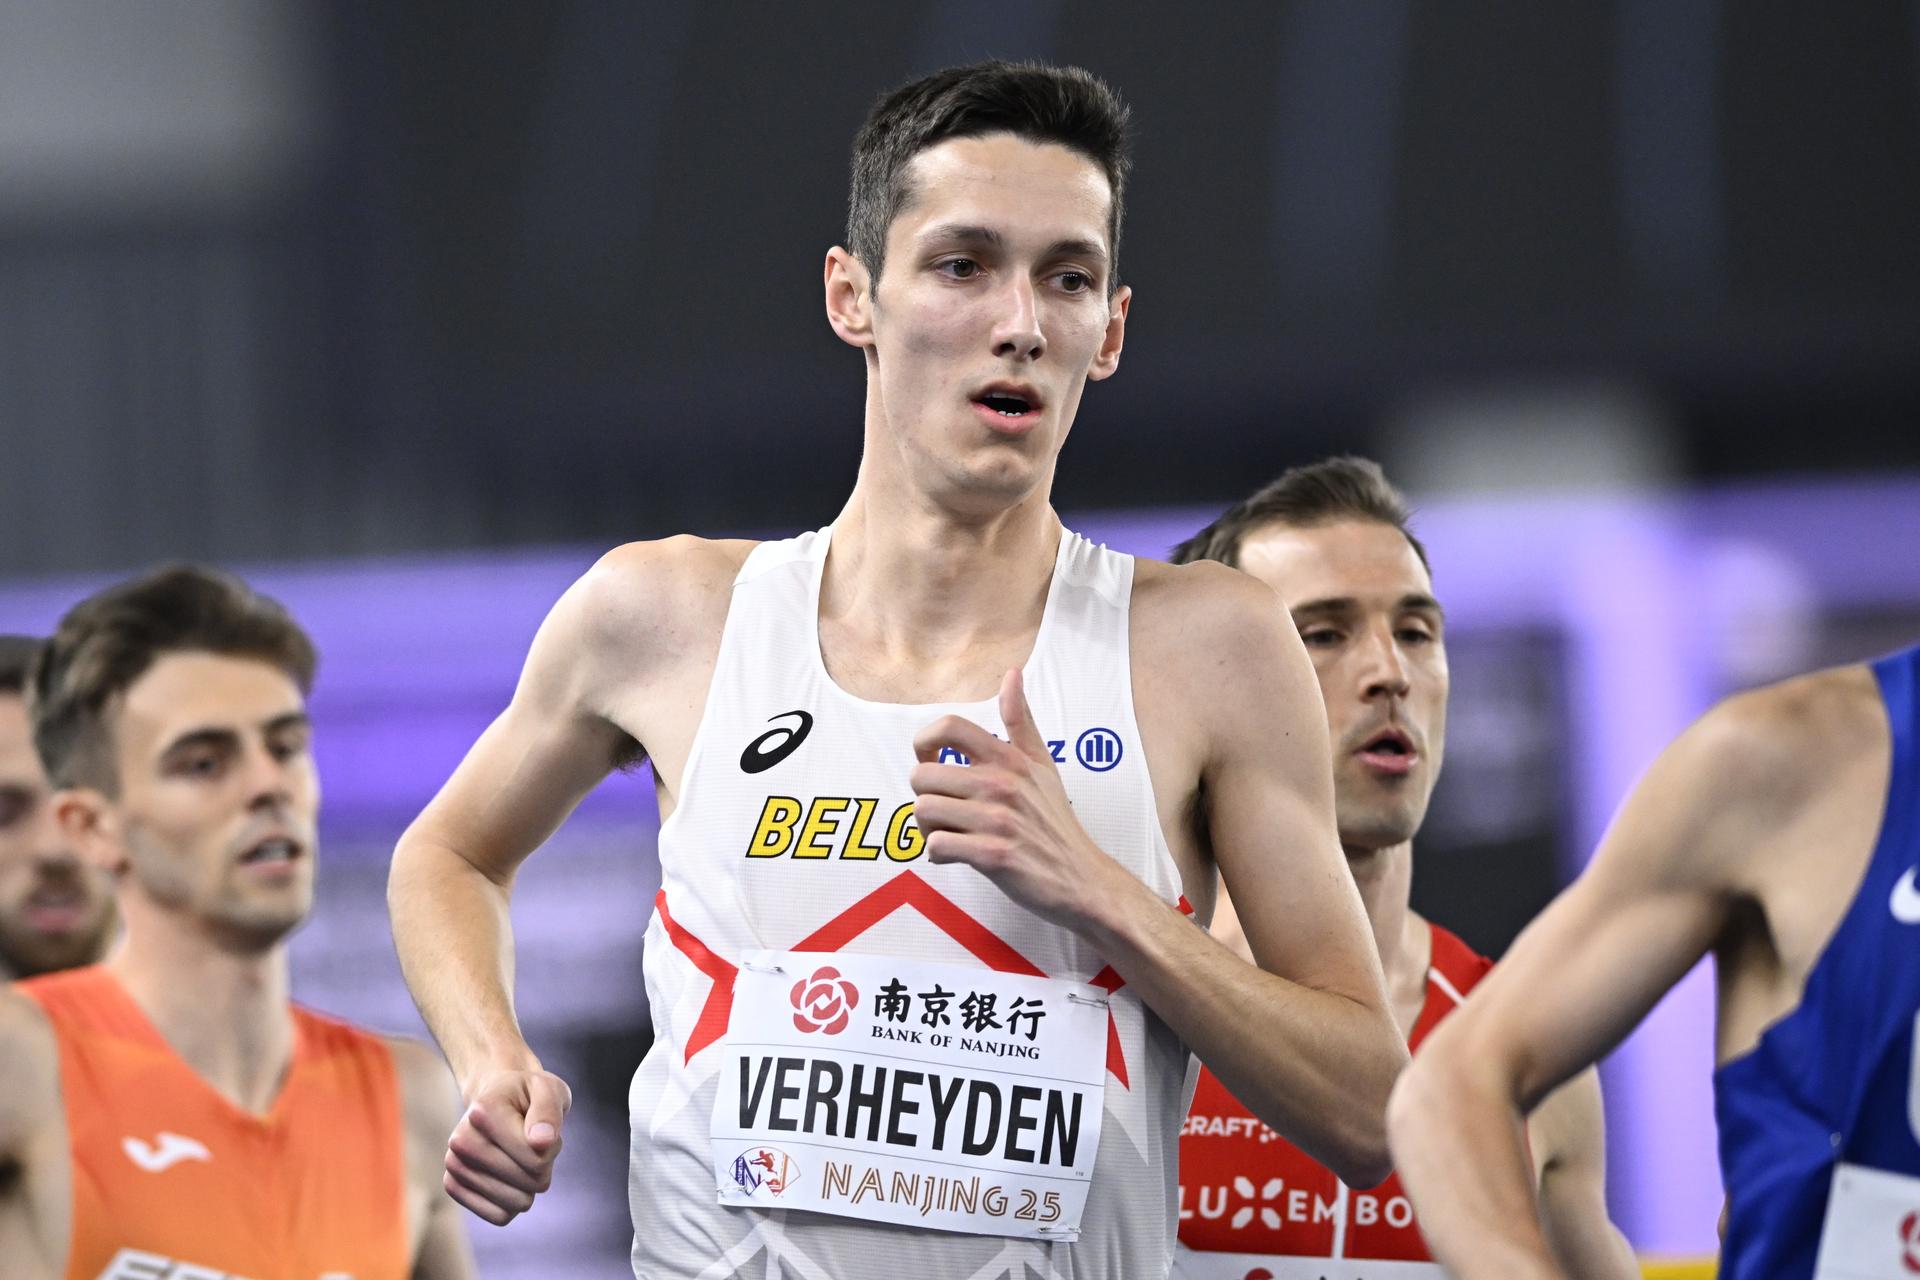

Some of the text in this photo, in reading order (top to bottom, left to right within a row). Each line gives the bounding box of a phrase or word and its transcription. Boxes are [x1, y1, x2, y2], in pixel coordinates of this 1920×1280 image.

[746, 796, 929, 862] BELG
[874, 977, 1047, 1041] 南京银行
[871, 1025, 1040, 1060] BANK OF NANJING
[738, 1056, 1083, 1167] VERHEYDEN
[821, 1161, 1061, 1222] NANJING 25
[1178, 1176, 1413, 1230] LUXEMBO
